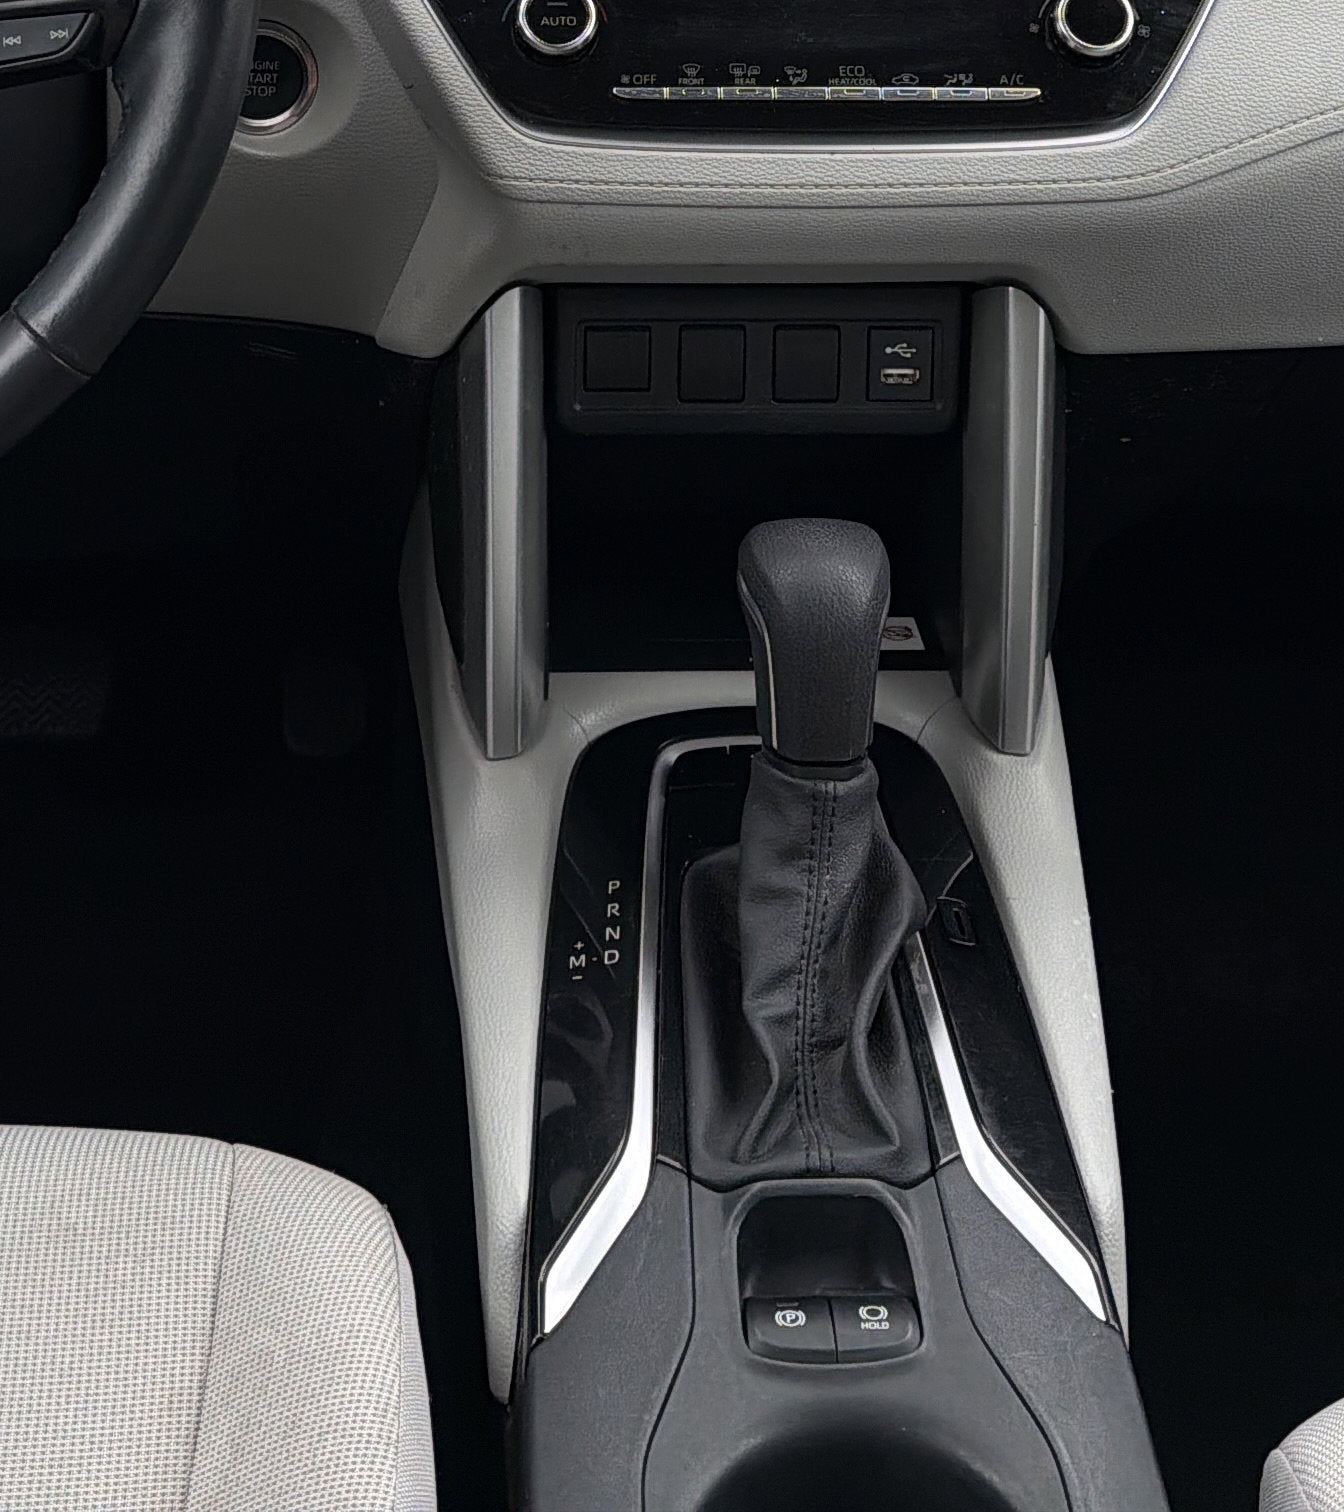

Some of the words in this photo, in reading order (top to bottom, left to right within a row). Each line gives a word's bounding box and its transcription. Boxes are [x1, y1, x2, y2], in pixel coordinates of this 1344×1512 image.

[540, 16, 577, 26] AUTO
[255, 61, 280, 70] GINE
[839, 66, 865, 76] ECO
[249, 73, 278, 84] TART
[633, 74, 657, 85] OFF
[829, 78, 877, 86] HEAT/COOL
[1000, 74, 1024, 85] A/C
[245, 86, 277, 97] STOP
[608, 880, 620, 894] P
[607, 903, 620, 917] R
[605, 926, 620, 941] N
[569, 954, 586, 969] M
[604, 950, 619, 964] D
[861, 1322, 889, 1330] HOLD
